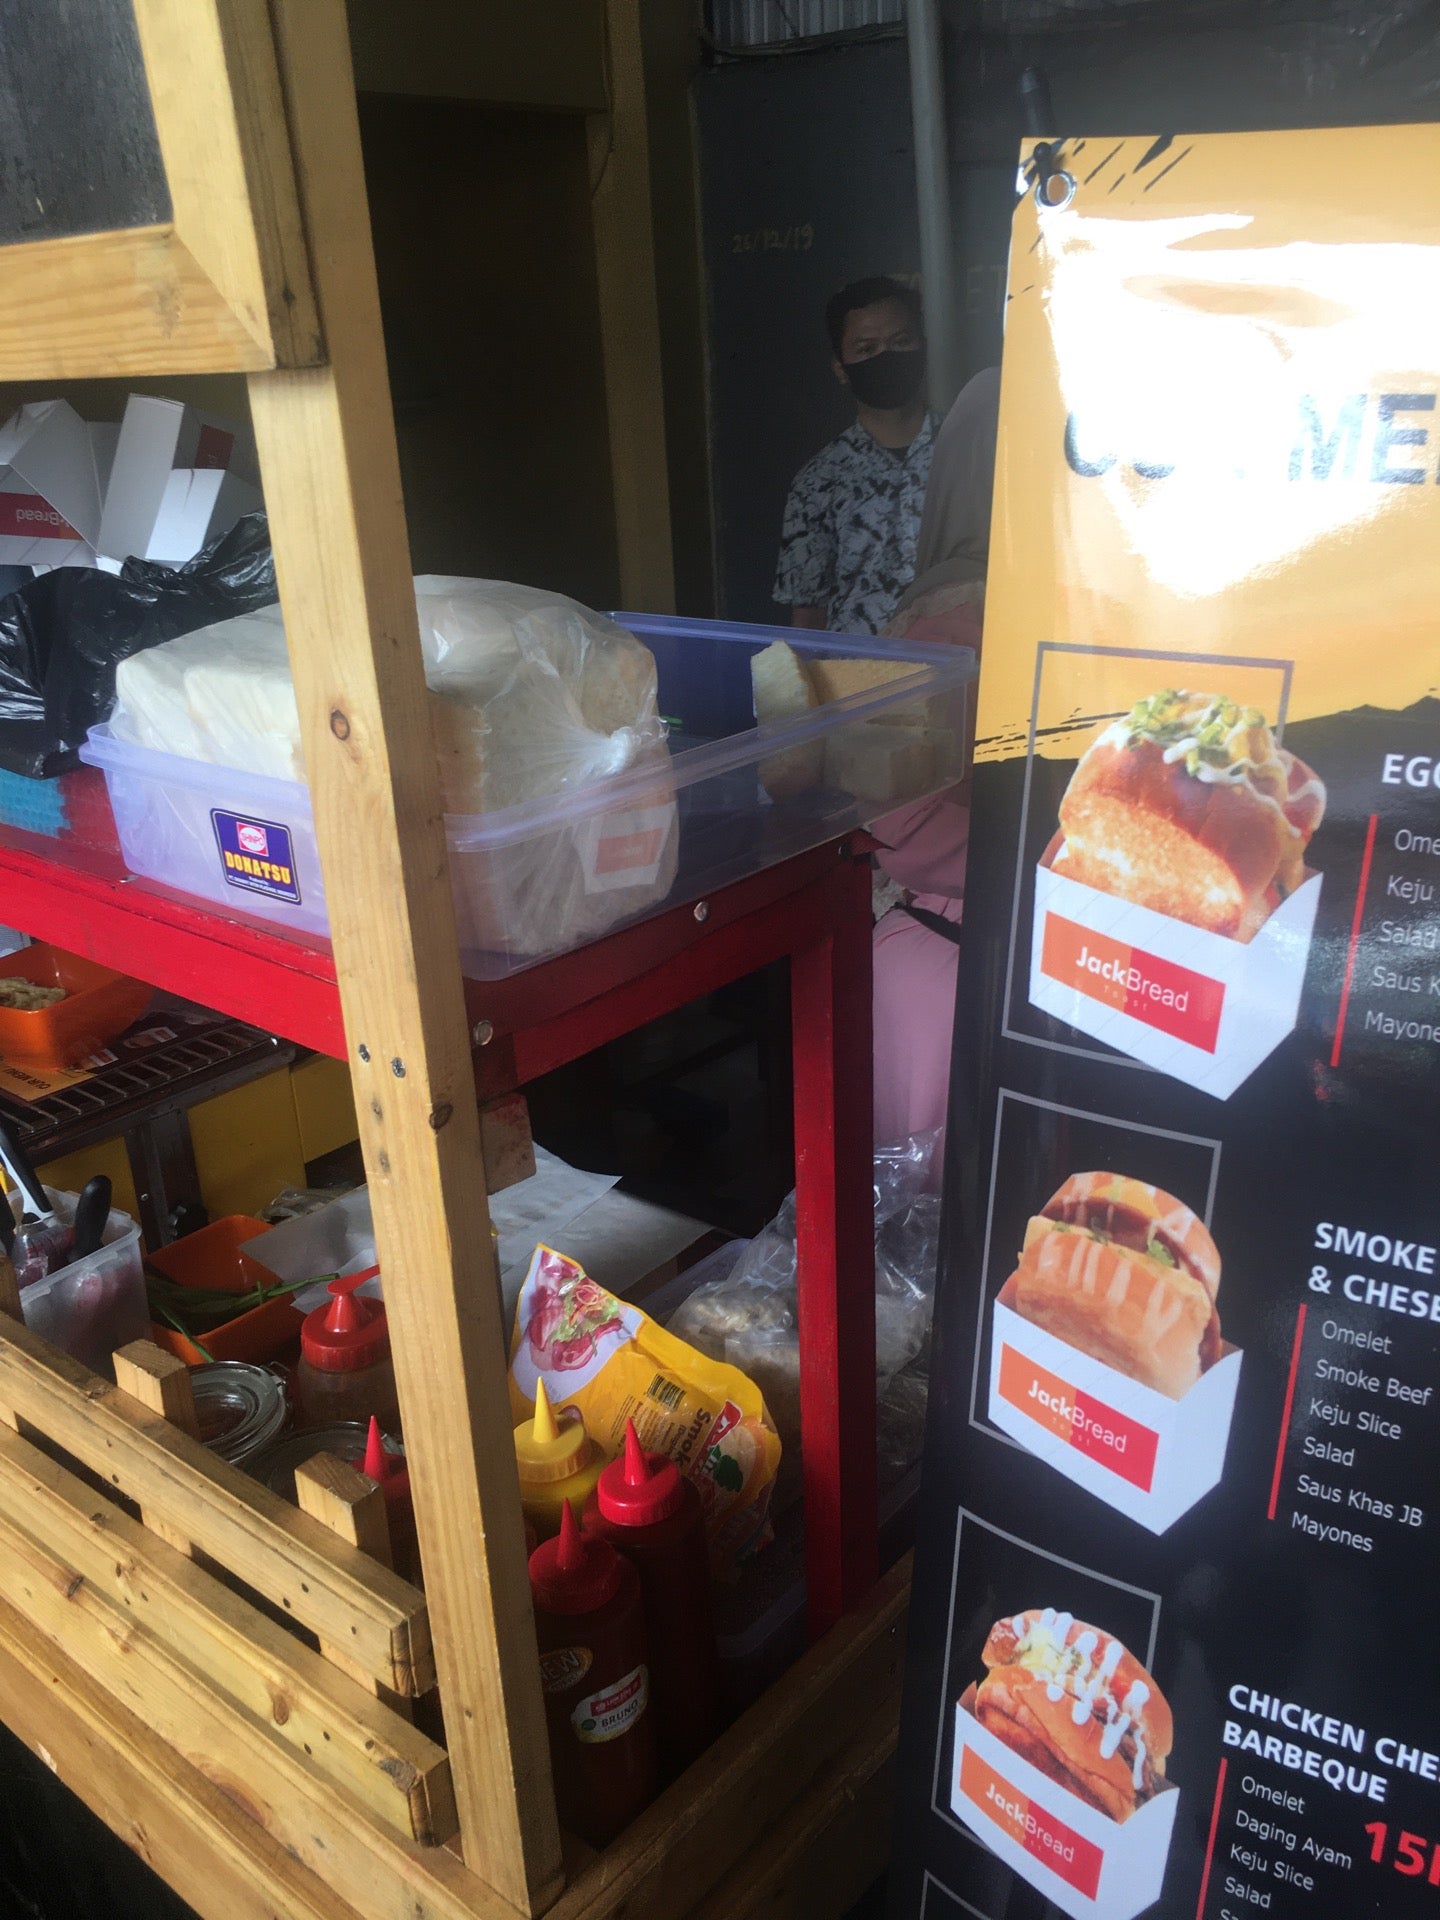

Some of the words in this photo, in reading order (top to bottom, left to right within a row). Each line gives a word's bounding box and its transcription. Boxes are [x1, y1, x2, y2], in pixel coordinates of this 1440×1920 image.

[1287, 392, 1440, 486] ME
[16, 508, 69, 527] Bread
[224, 850, 292, 885] DONATSU
[1387, 875, 1433, 904] Keju
[1380, 920, 1438, 949] Salad
[1075, 946, 1189, 1012] JackBread
[1371, 965, 1422, 993] Saus
[1314, 1221, 1437, 1275] SMOKE
[1308, 1265, 1332, 1295] &
[1322, 1320, 1392, 1355] Omelet
[1315, 1359, 1381, 1393] Smoke
[1386, 1377, 1433, 1406] Beef
[1028, 1379, 1127, 1453] JackBread
[1310, 1397, 1351, 1426] Keju
[1356, 1411, 1402, 1440] Slice
[1303, 1436, 1355, 1467] Salad
[1297, 1474, 1342, 1503] Saus
[1347, 1489, 1394, 1519] Khas
[1398, 1504, 1424, 1527] JB
[1291, 1511, 1373, 1552] Mayones
[1229, 1684, 1366, 1754] CHICKEN
[1375, 1737, 1440, 1783] CHE
[1223, 1720, 1388, 1803] BARBEQUE
[1241, 1775, 1306, 1815] Omelet
[985, 1782, 1075, 1863] JackBread
[1235, 1809, 1297, 1850] Daging
[1301, 1837, 1352, 1870] Ayam
[1230, 1843, 1268, 1871] Keju
[1273, 1861, 1315, 1891] Slice
[1224, 1876, 1271, 1909] Salad
